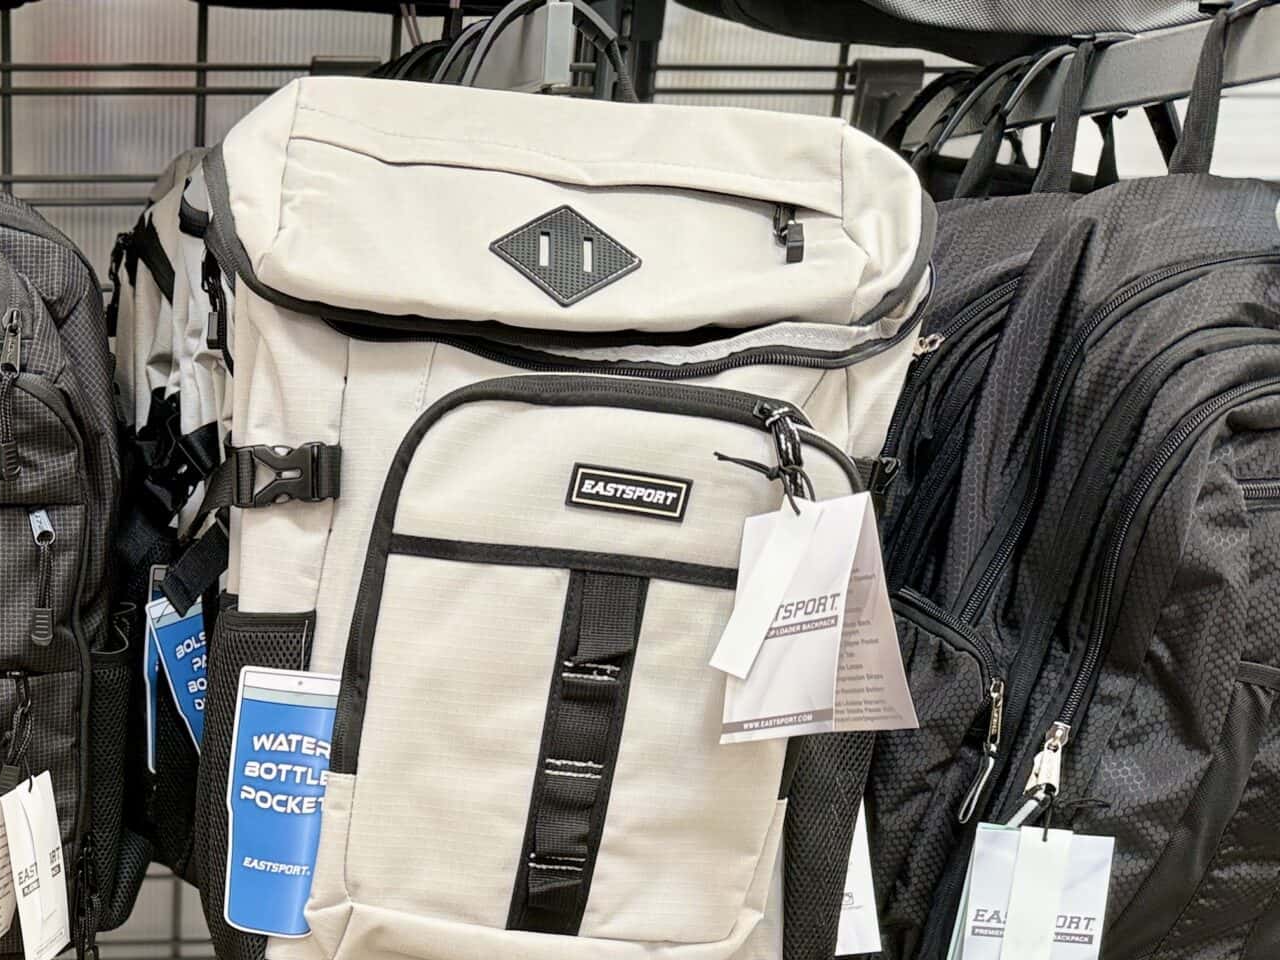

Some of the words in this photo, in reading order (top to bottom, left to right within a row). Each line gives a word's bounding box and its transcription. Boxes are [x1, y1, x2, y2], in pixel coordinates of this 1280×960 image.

[580, 479, 677, 505] EASTSPORT
[802, 618, 836, 633] BACKPACK
[743, 713, 813, 730] WWW.EASTSPORT.COM
[252, 733, 331, 759] WATER
[244, 761, 329, 786] BOTTLE
[1054, 933, 1090, 943] ACKPACK
